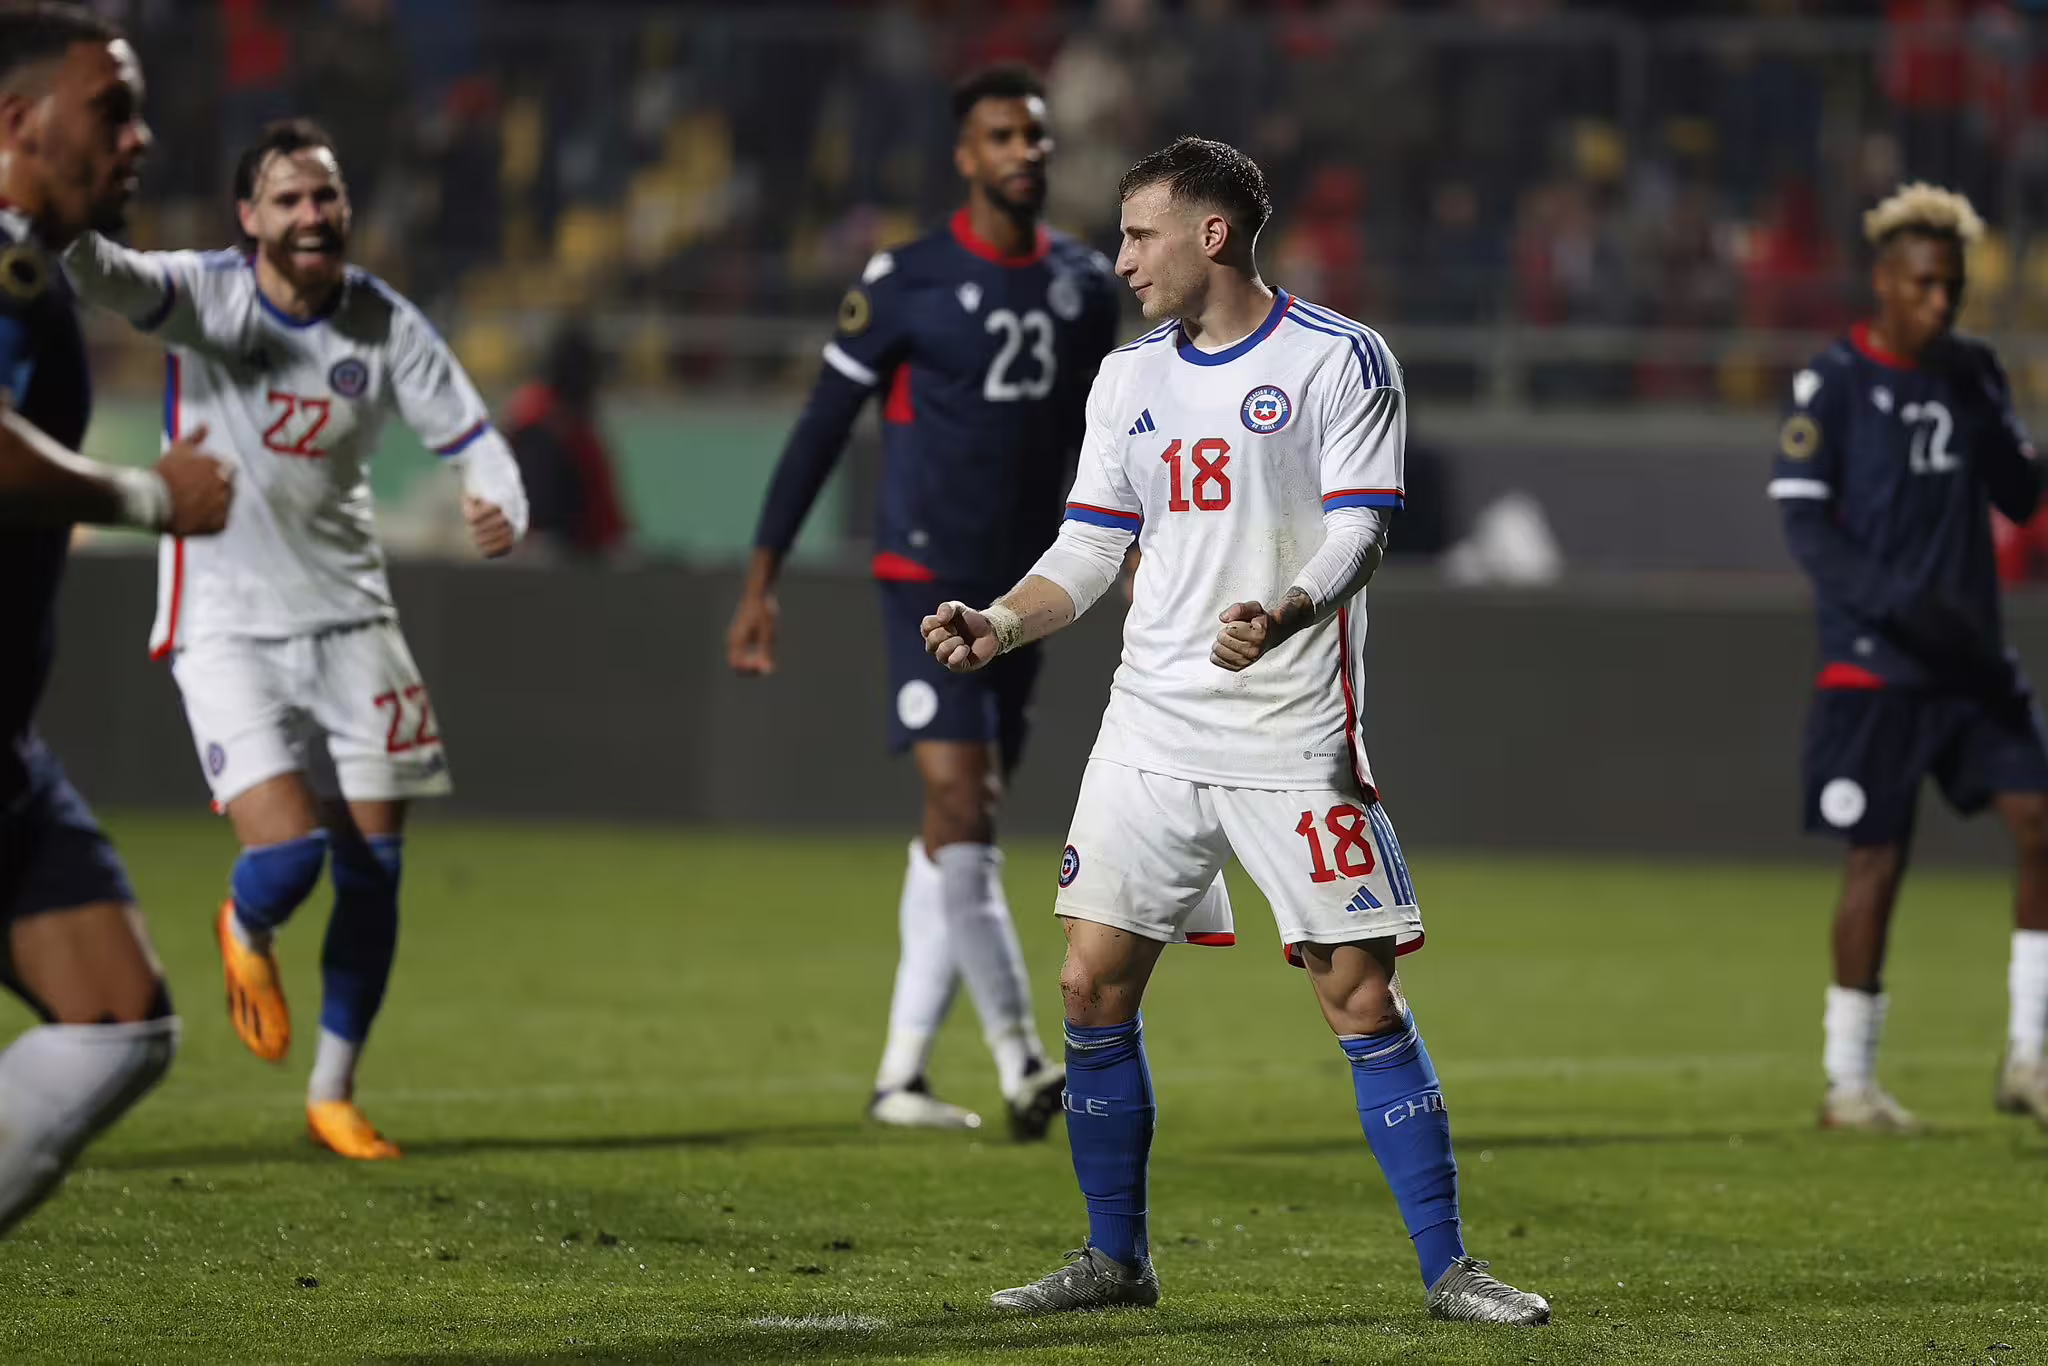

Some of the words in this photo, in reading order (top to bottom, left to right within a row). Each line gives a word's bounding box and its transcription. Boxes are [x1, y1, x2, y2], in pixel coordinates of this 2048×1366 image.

[983, 308, 1056, 401] 23
[263, 392, 329, 457] 22
[1160, 438, 1232, 512] 18
[373, 686, 440, 752] 22
[1295, 803, 1376, 883] 18
